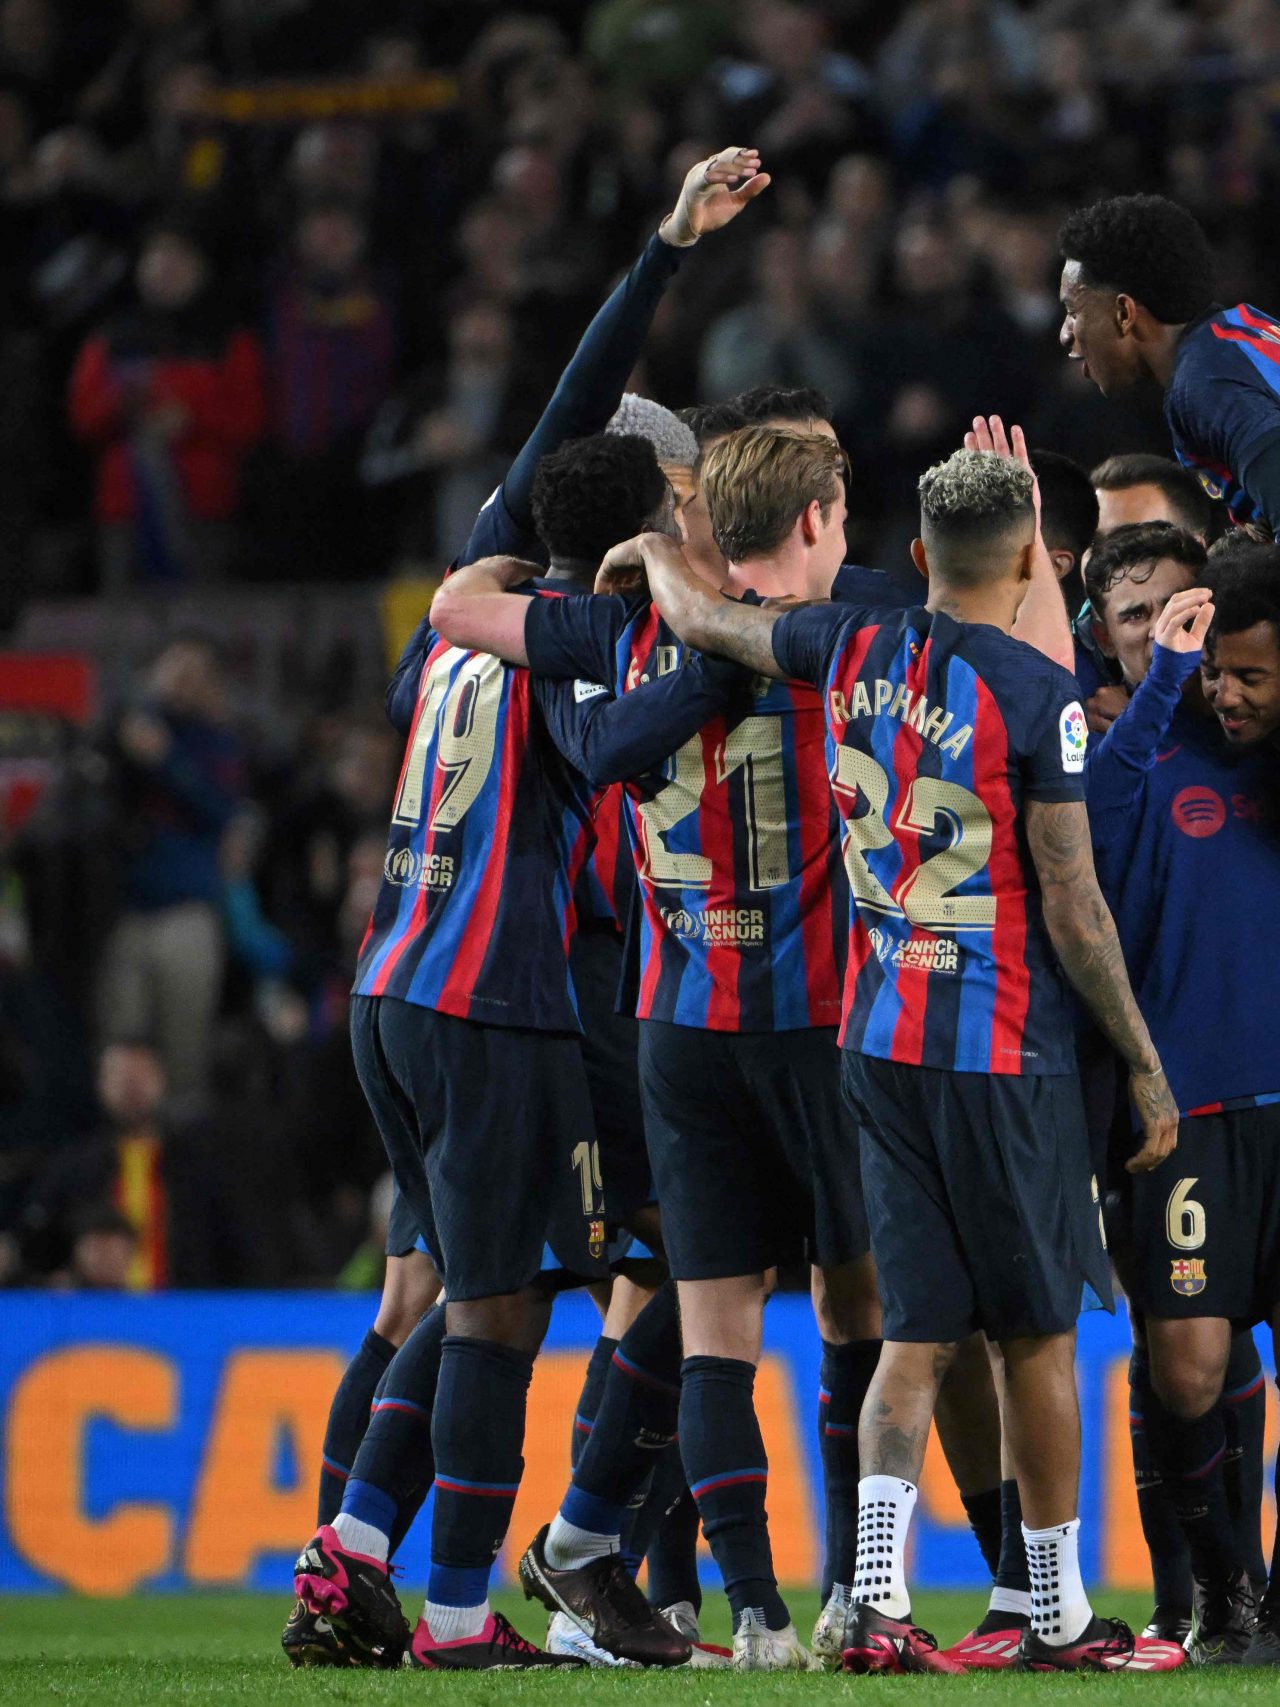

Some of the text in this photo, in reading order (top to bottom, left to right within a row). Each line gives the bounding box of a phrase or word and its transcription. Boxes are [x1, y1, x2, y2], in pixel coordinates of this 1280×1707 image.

[392, 646, 503, 833] 19
[638, 714, 790, 892] 21
[828, 743, 998, 933] 22
[698, 909, 764, 925] UNHCR
[702, 924, 764, 940] ACNUR
[891, 949, 958, 971] ACNUR
[898, 939, 958, 956] UNHCR
[1165, 1177, 1207, 1251] 6
